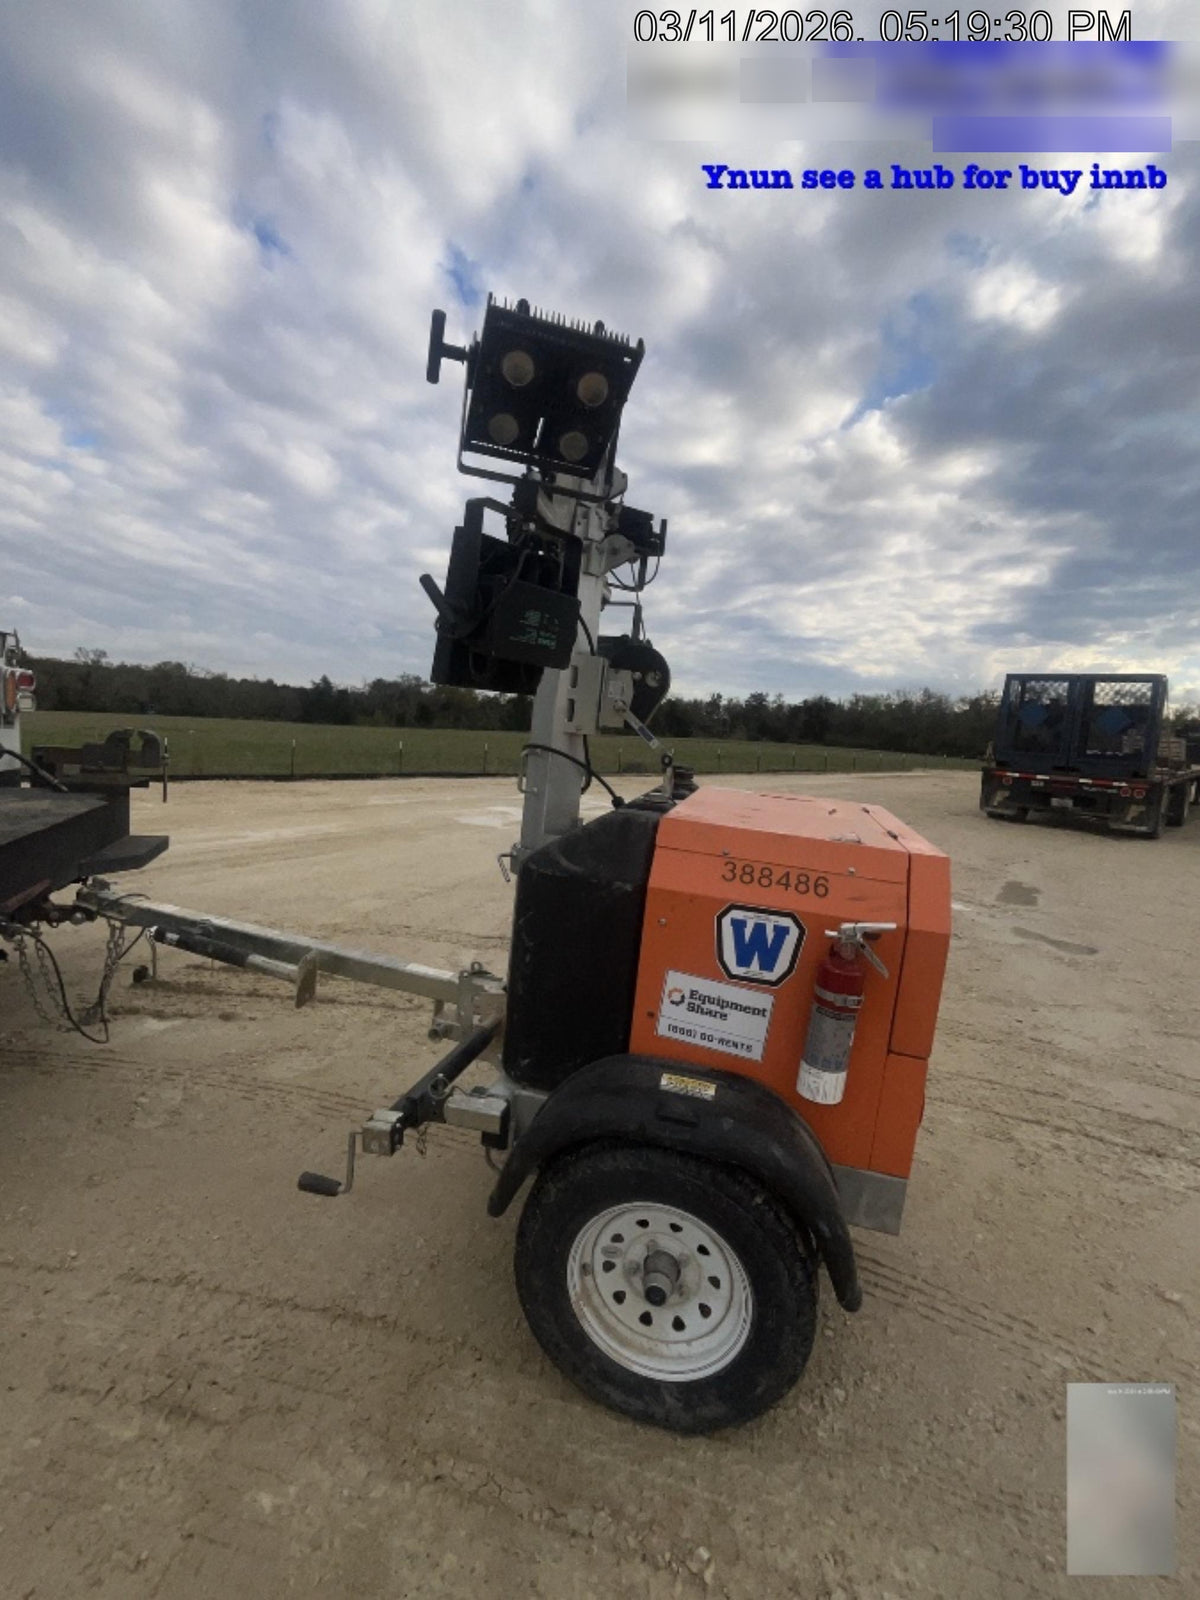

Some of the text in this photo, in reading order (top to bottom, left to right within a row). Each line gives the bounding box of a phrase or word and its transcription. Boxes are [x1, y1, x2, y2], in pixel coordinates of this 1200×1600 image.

[720, 860, 830, 899] 388486
[730, 917, 790, 973] W
[686, 1001, 728, 1021] Share
[688, 988, 768, 1018] Equipment
